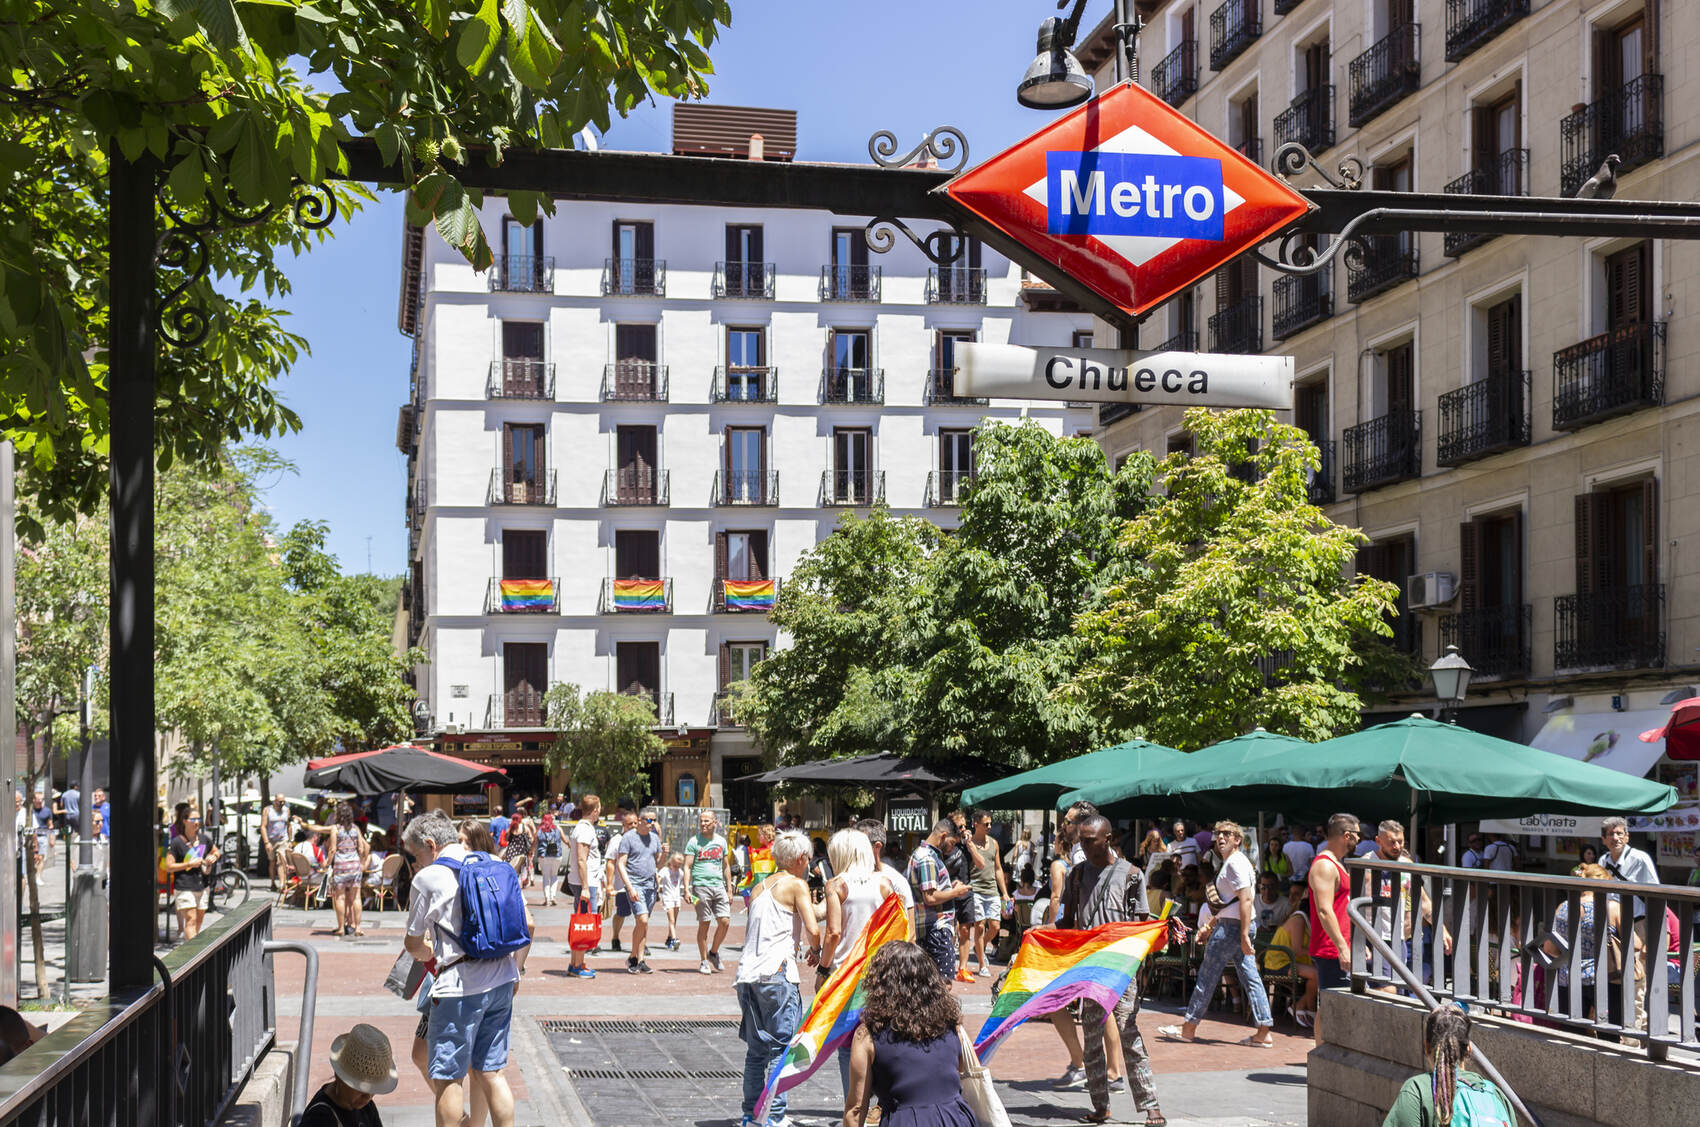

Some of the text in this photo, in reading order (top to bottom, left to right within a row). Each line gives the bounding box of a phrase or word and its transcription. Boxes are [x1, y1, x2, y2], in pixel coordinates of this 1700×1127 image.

[1060, 169, 1215, 221] Metro
[1045, 356, 1208, 394] Chueca
[891, 807, 928, 817] LIQUIDACIÓN
[891, 816, 928, 831] TOTAL
